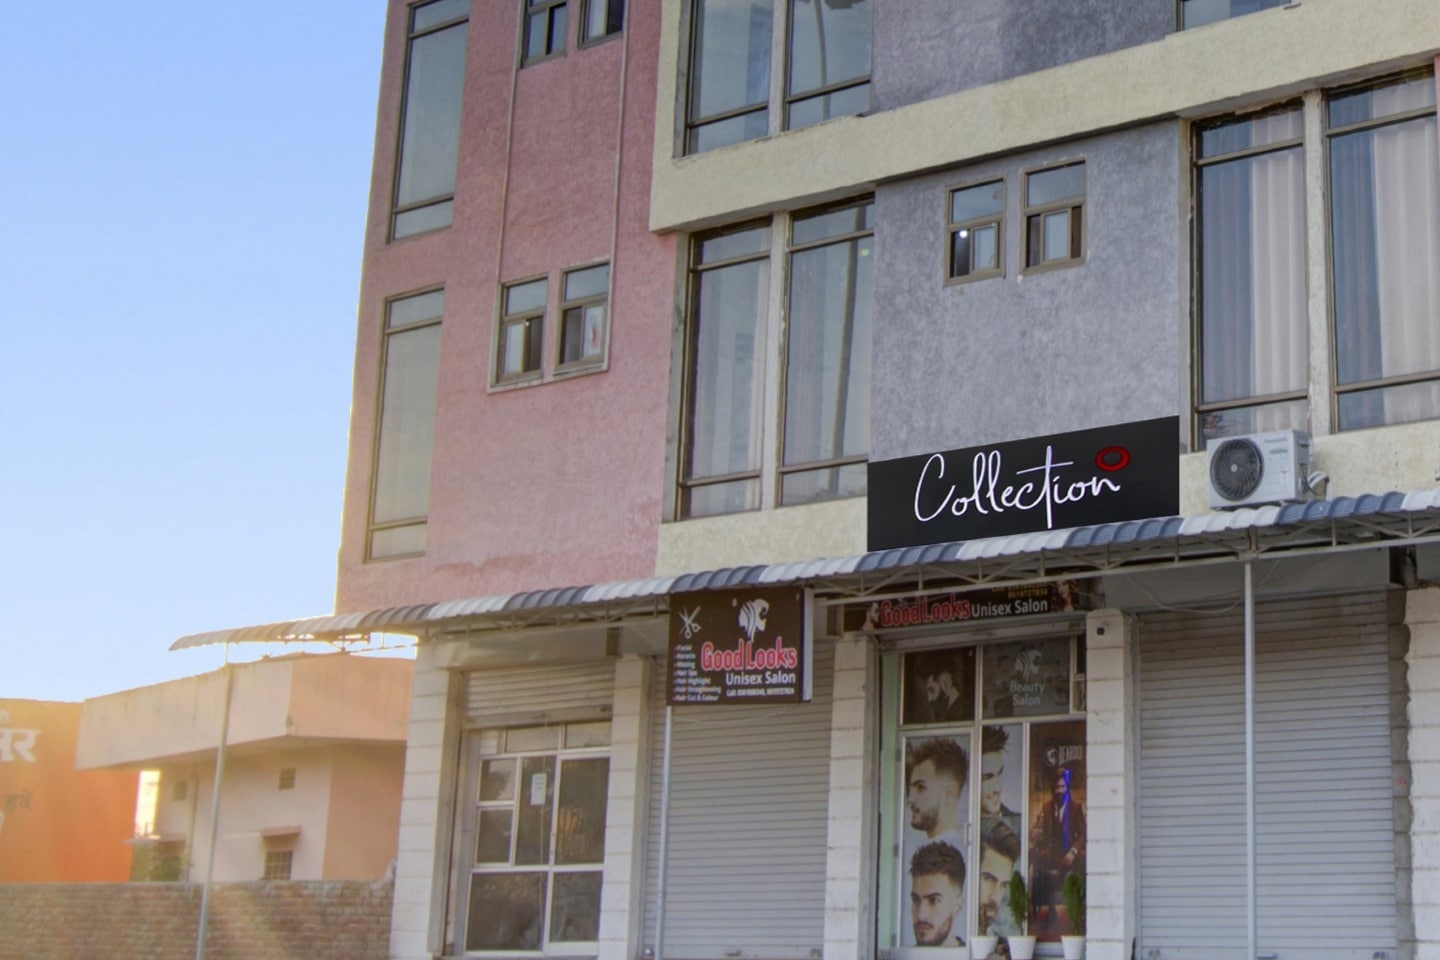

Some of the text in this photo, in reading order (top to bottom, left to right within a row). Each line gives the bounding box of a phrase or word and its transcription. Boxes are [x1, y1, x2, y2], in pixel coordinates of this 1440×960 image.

[914, 445, 1121, 529] Collection
[880, 592, 1048, 627] Good Looks Unisex Salon
[700, 636, 798, 671] Good Looks
[725, 670, 796, 686] Unisex Salon
[1010, 680, 1045, 695] Beauty
[1012, 693, 1040, 706] Salon
